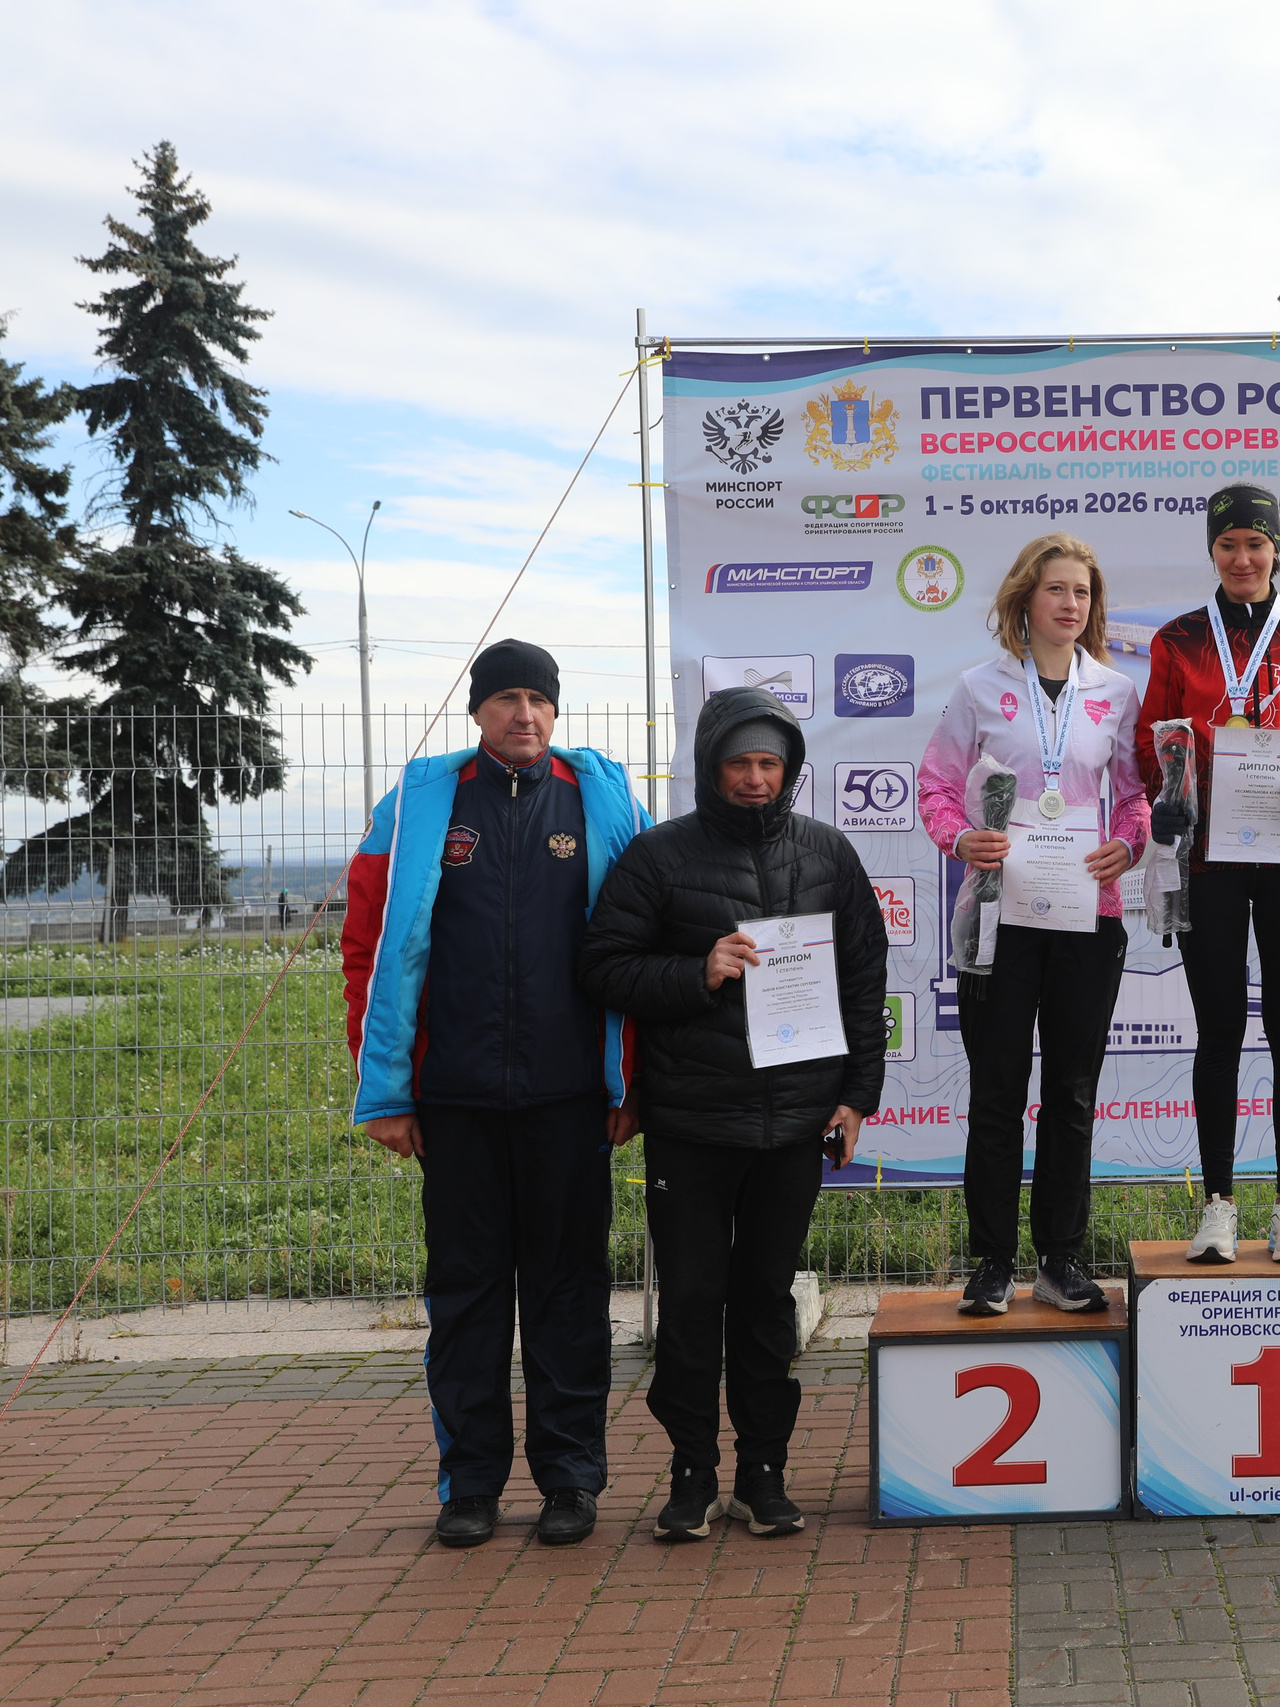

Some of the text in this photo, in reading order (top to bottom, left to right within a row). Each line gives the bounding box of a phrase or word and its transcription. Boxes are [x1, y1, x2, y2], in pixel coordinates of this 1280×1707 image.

[920, 382, 1225, 420] ПЕРВЕНСТВО
[920, 424, 1176, 454] ВСЕРОССИЙСКИЕ
[920, 462, 1052, 482] ФЕСТИВАЛЬ
[1056, 460, 1217, 480] СПОРТИВНОГО
[705, 481, 783, 493] МИНСПОРТ
[715, 498, 775, 509] РОССИИ
[925, 495, 937, 515] 1
[960, 494, 975, 515] 5
[980, 493, 1079, 520] октября
[1084, 491, 1148, 513] 2026
[1154, 496, 1208, 512] года
[727, 566, 866, 581] МИНСПОРТ
[842, 817, 907, 827] АВИАСТАР
[1027, 834, 1074, 843] ДИПЛОМ
[767, 952, 812, 967] ДИПЛОМ
[779, 966, 804, 974] степень
[1167, 1289, 1262, 1304] ФЕДЕРАЦИЯ
[952, 1362, 1048, 1487] 2
